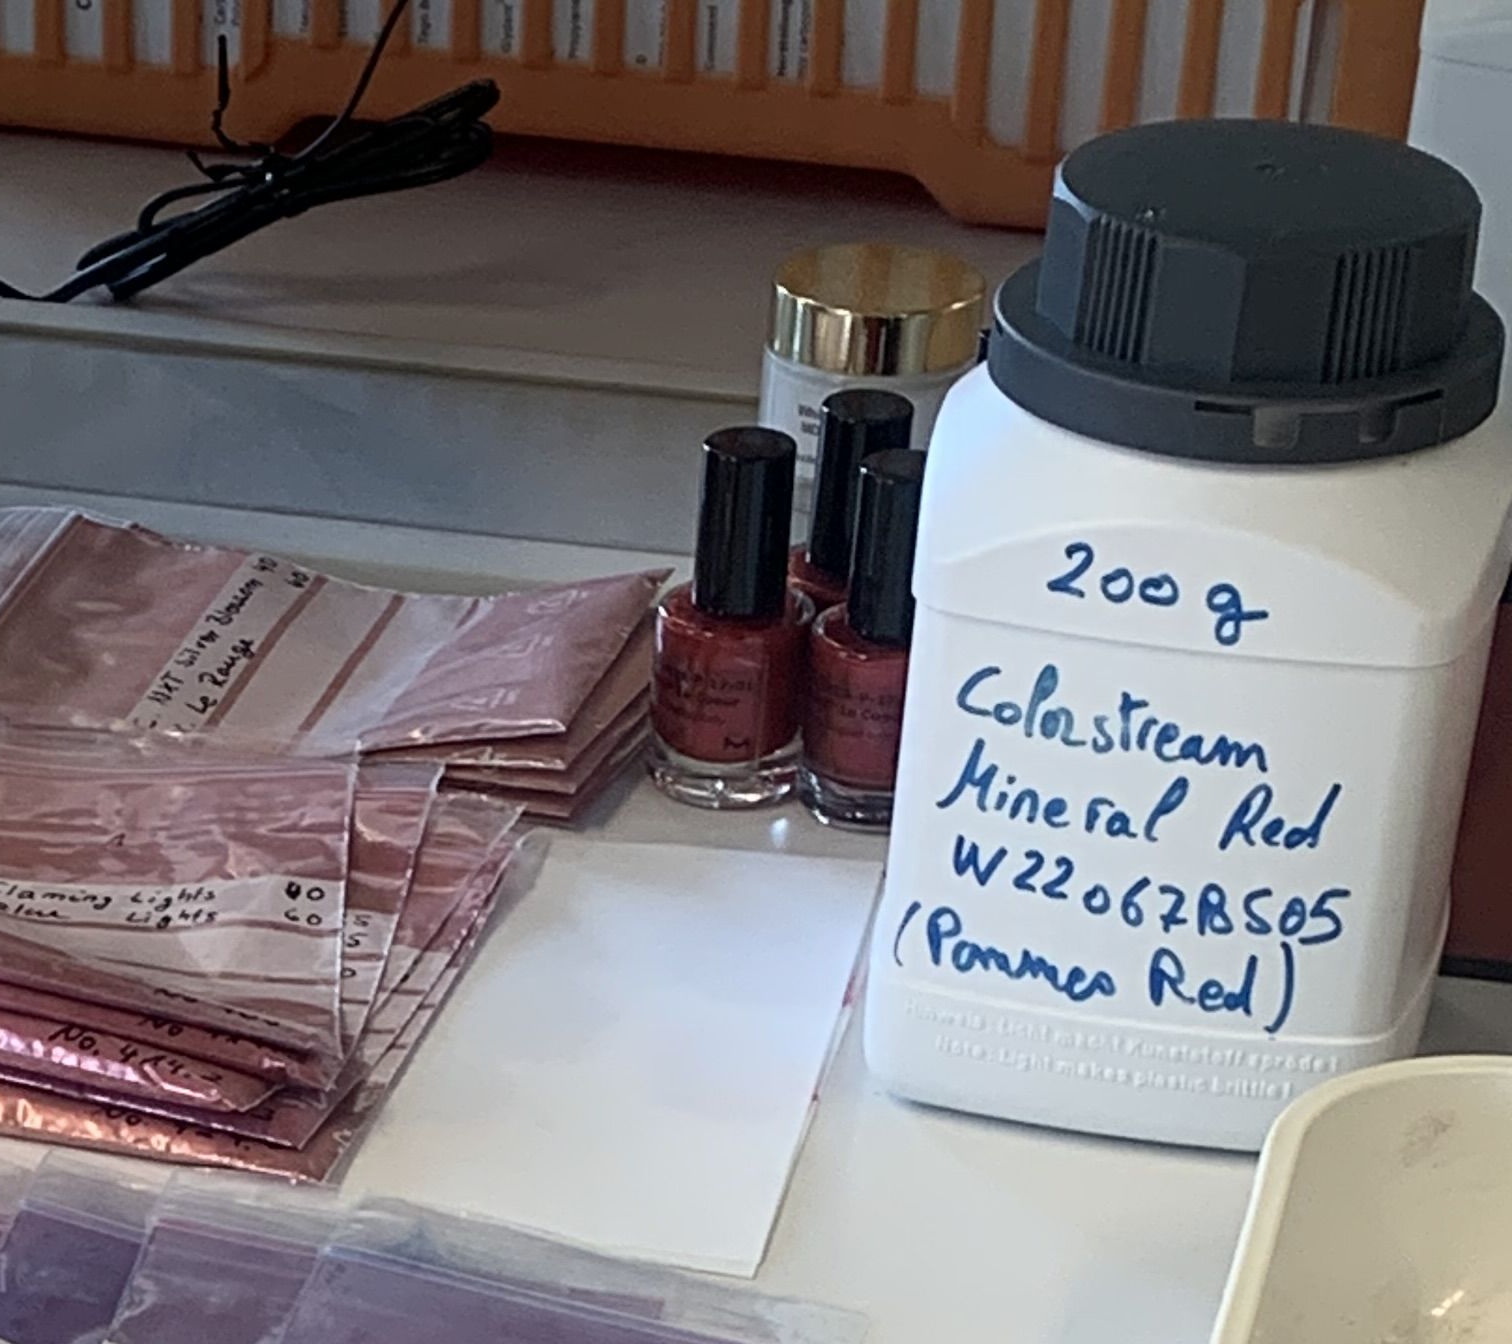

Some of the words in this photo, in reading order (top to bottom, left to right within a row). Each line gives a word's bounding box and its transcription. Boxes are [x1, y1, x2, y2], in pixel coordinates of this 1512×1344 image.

[1046, 542, 1179, 606] 200
[1206, 583, 1269, 646] g
[956, 664, 1268, 772] Colorstream
[936, 738, 1189, 842] Mineral
[1218, 783, 1342, 850] Red
[130, 887, 217, 912] Lights
[1149, 942, 1295, 1035] Red)
